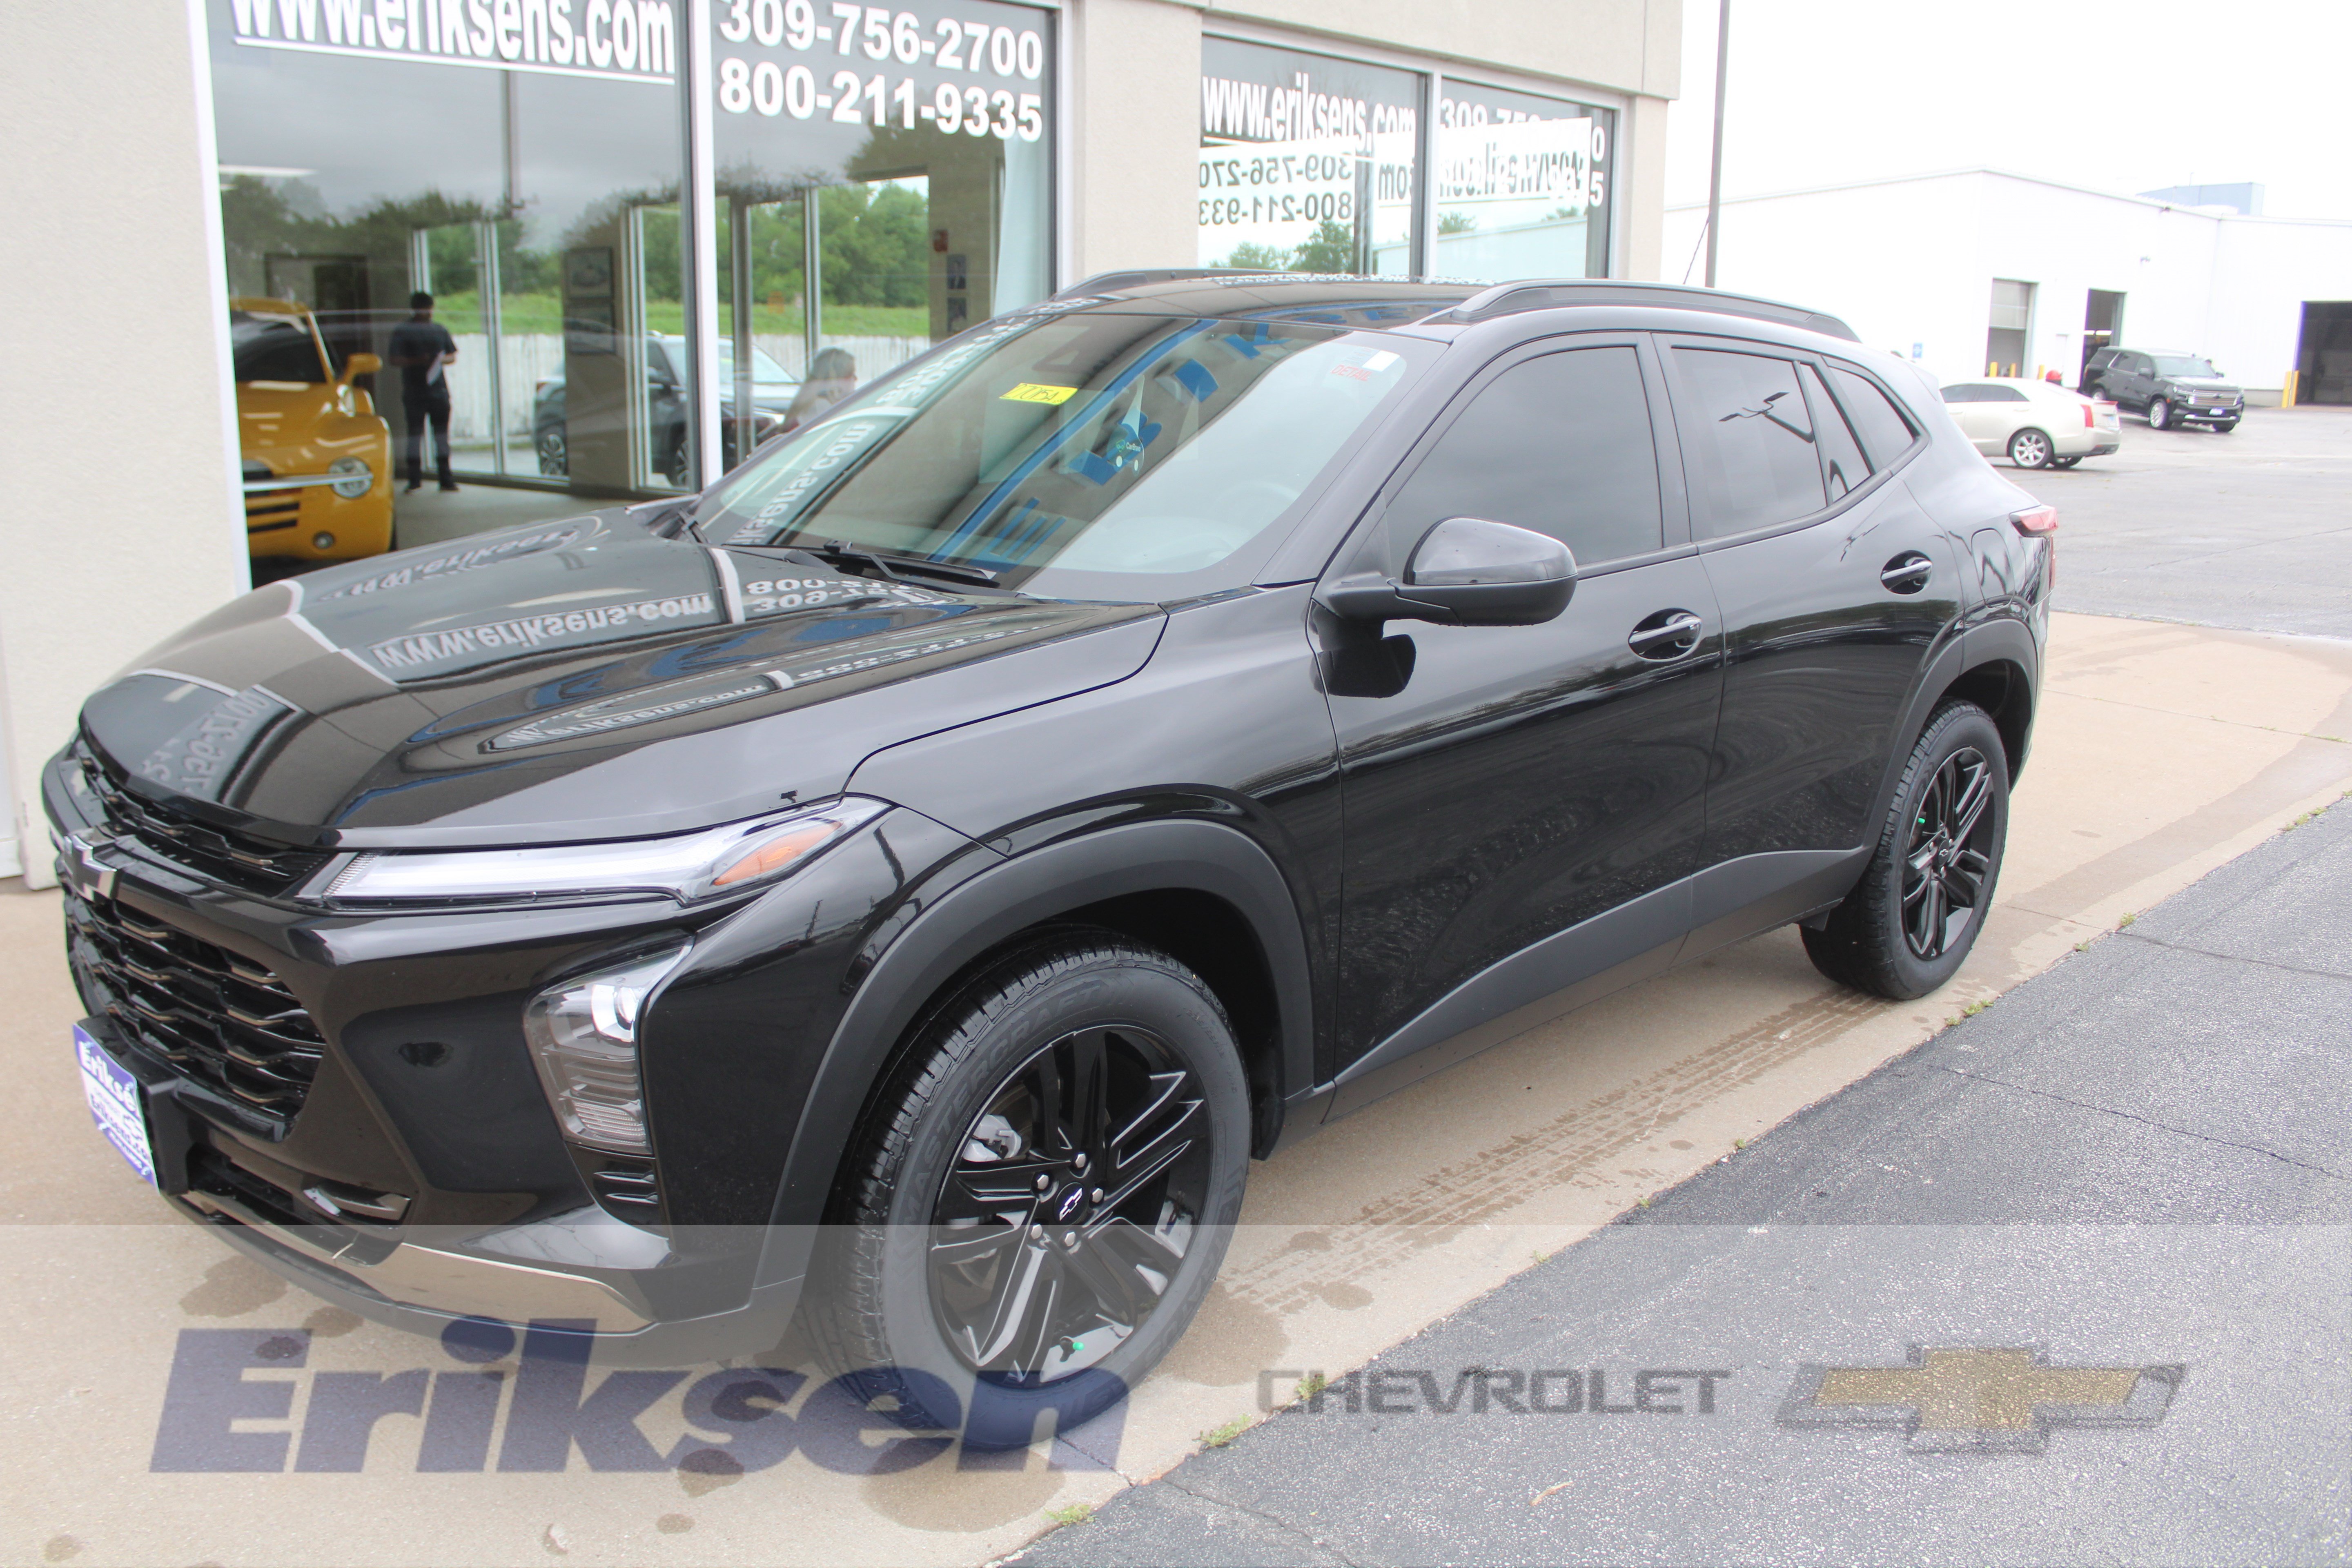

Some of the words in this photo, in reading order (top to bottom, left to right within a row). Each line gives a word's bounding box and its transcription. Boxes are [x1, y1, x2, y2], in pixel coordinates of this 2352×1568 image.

[719, 0, 1042, 80] 309-756-2700
[719, 58, 1042, 143] 800-211-9335
[1203, 71, 1416, 153] www.eriksens.com
[1330, 364, 1372, 381] DETAIL
[904, 985, 1102, 1226] MASTERCRAFT
